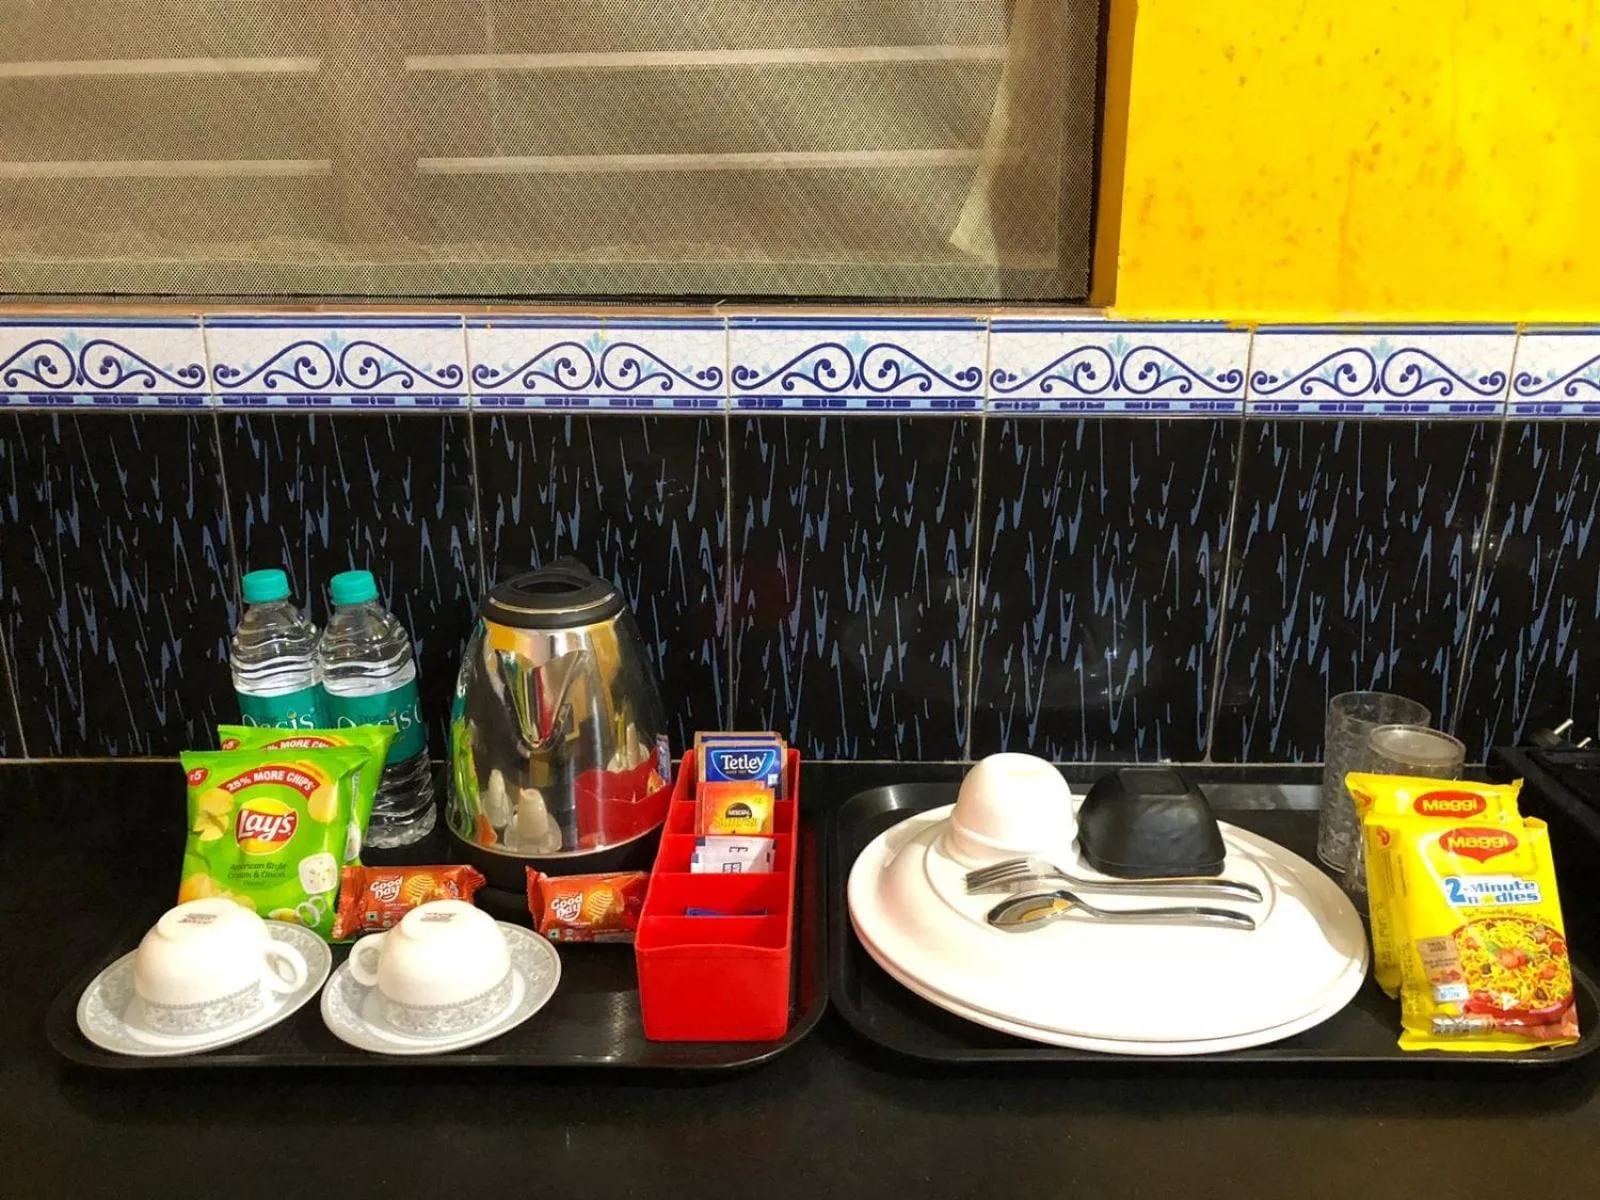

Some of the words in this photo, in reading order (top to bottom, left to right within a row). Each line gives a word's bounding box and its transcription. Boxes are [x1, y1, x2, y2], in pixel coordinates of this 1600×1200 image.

[242, 711, 314, 730] Ois
[720, 753, 768, 774] Tetley
[227, 777, 252, 791] 25%
[254, 769, 285, 781] MORE
[286, 772, 315, 791] CHIPS
[1422, 798, 1478, 812] Maggi
[238, 809, 295, 843] Lay's
[1447, 834, 1509, 849] Maggi
[370, 876, 404, 893] Good
[374, 884, 402, 903] Day
[551, 893, 583, 910] Good
[555, 902, 582, 922] Day
